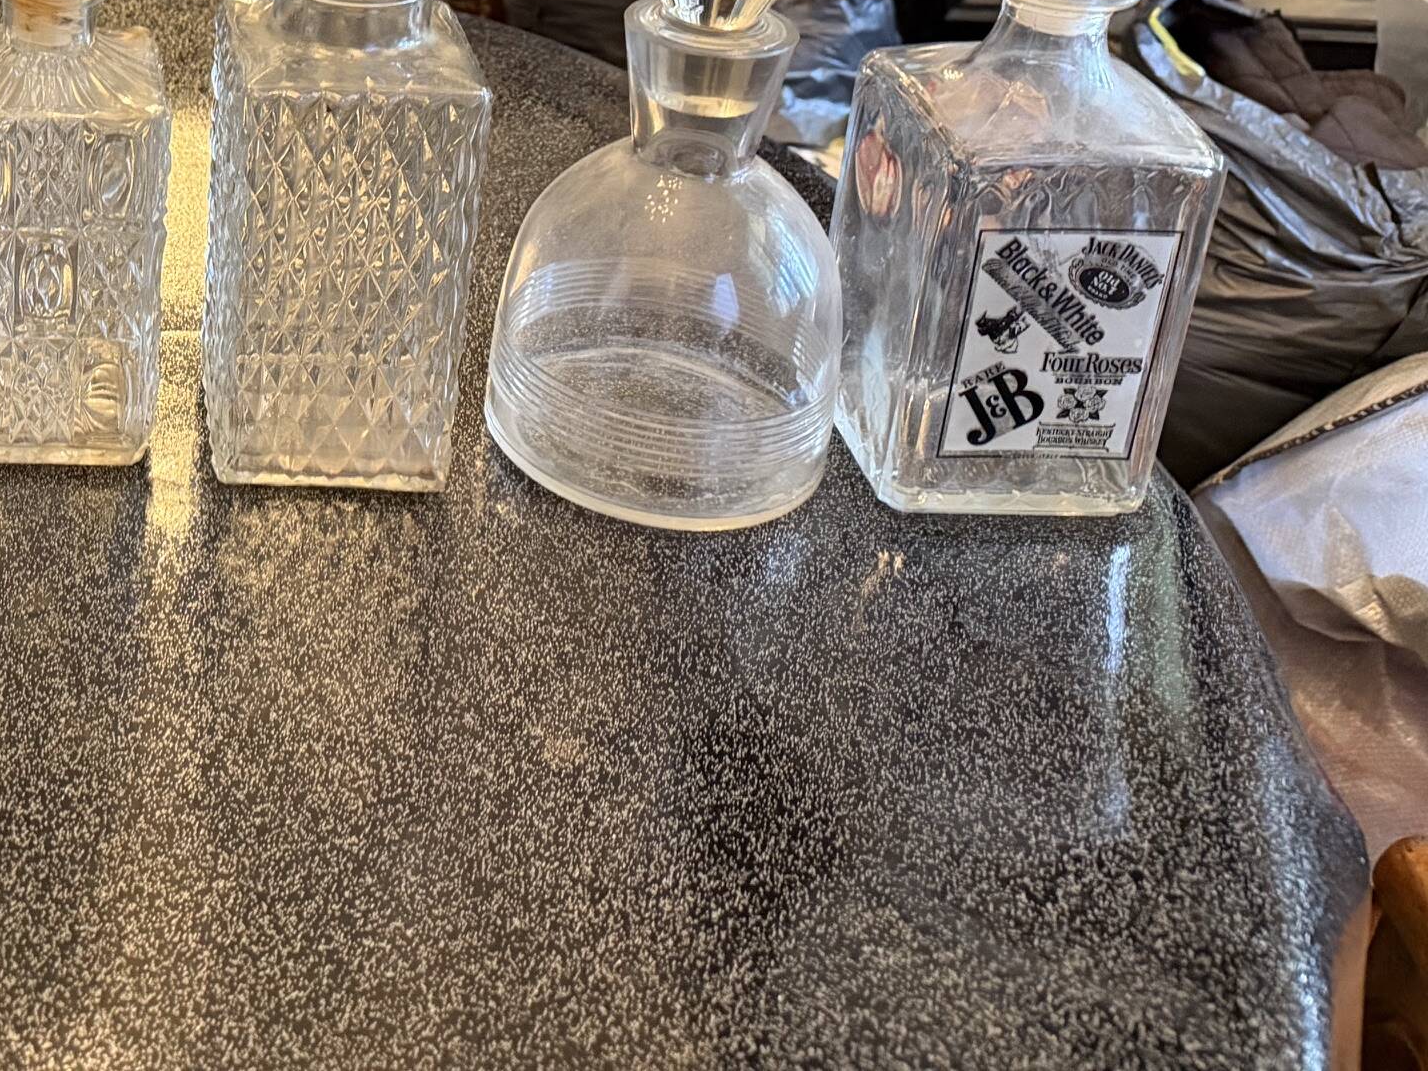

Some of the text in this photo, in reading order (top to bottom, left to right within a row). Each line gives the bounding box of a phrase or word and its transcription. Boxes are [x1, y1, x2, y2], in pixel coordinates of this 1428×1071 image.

[1082, 236, 1119, 258] JACK
[996, 237, 1048, 290] Black
[1052, 287, 1104, 346] White
[1039, 352, 1143, 374] Four Roses
[961, 361, 1006, 389] RARE
[1055, 377, 1123, 385] BOURBON
